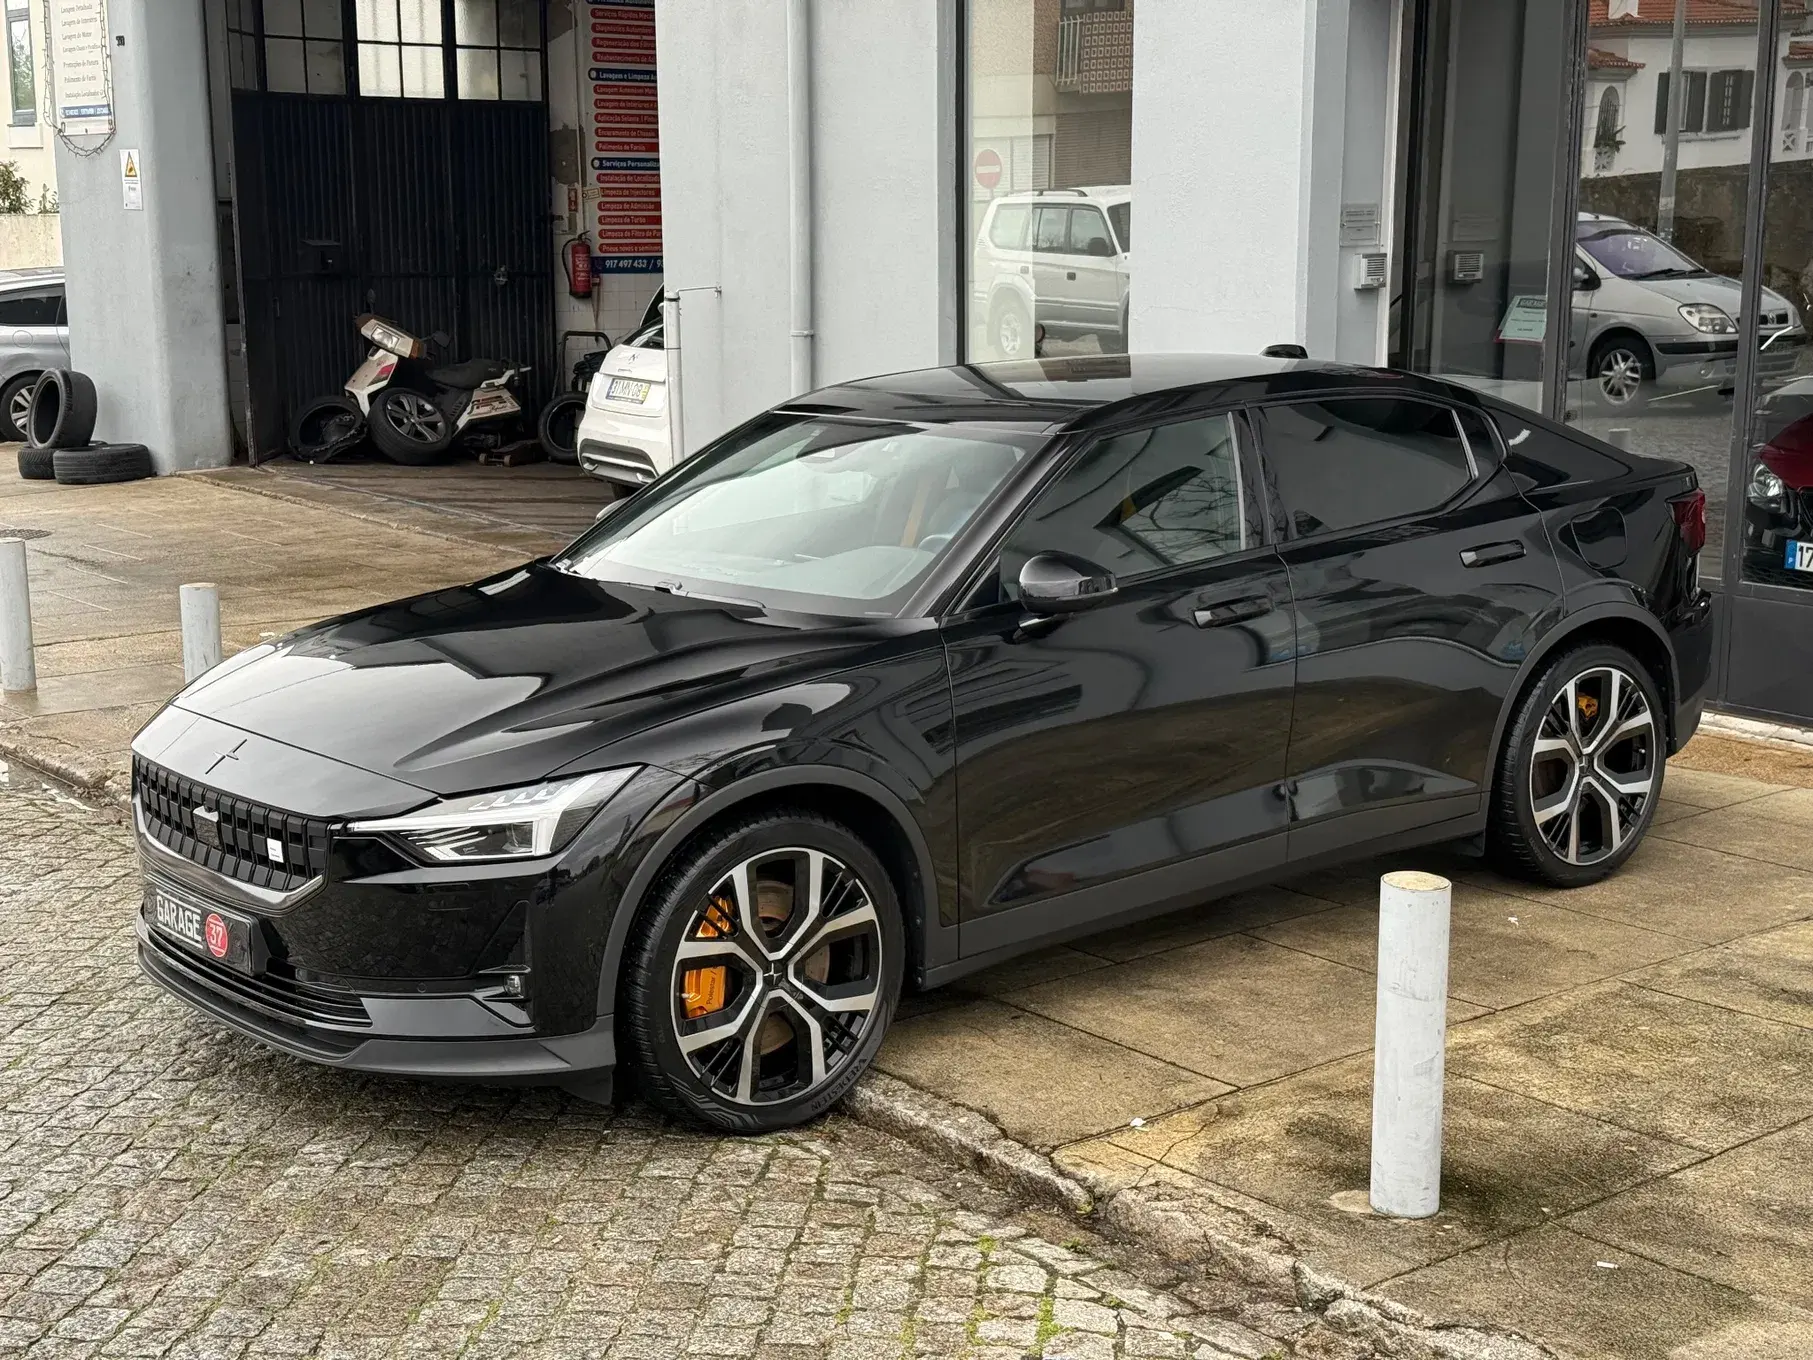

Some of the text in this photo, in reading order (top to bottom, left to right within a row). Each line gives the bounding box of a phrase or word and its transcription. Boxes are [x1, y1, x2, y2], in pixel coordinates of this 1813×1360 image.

[595, 9, 617, 18] Serviços
[599, 72, 623, 80] Lavagem
[602, 160, 626, 168] Serviços
[605, 260, 617, 268] 917
[619, 260, 632, 268] 497
[633, 260, 647, 268] 433
[1787, 556, 1794, 564] P
[156, 895, 203, 942] GARAGE
[209, 923, 223, 947] 37
[706, 977, 717, 1005] Polestar
[811, 1058, 869, 1112] VREDESTEIN
